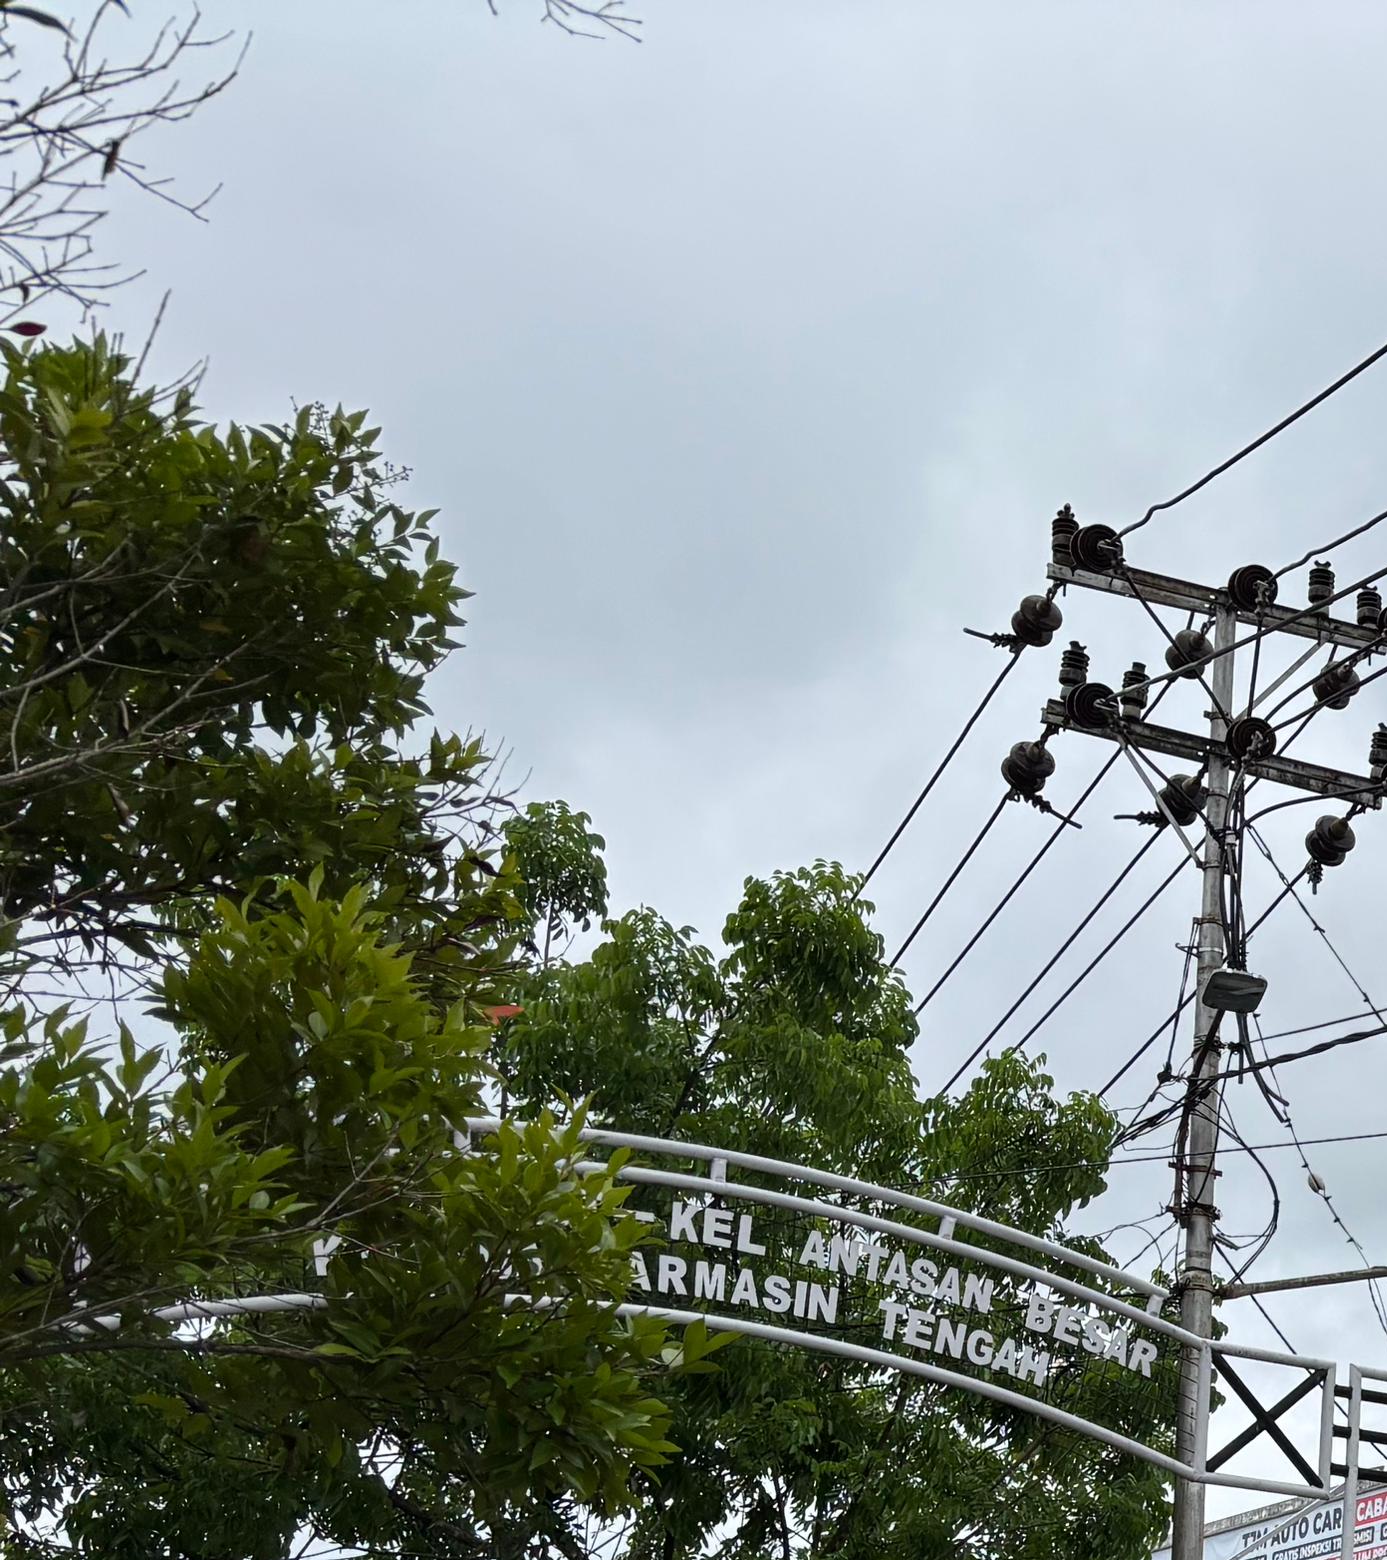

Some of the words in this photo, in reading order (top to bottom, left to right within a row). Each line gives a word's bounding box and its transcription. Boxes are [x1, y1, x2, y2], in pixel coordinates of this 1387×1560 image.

[628, 1251, 839, 1324] ARMASIN
[879, 1299, 1051, 1387] TENGAH
[668, 1200, 766, 1256] KEL
[799, 1229, 994, 1314] ANTASAN
[1024, 1291, 1159, 1379] BESAR
[1270, 1515, 1310, 1547] AUTO
[1313, 1506, 1343, 1536] CAR
